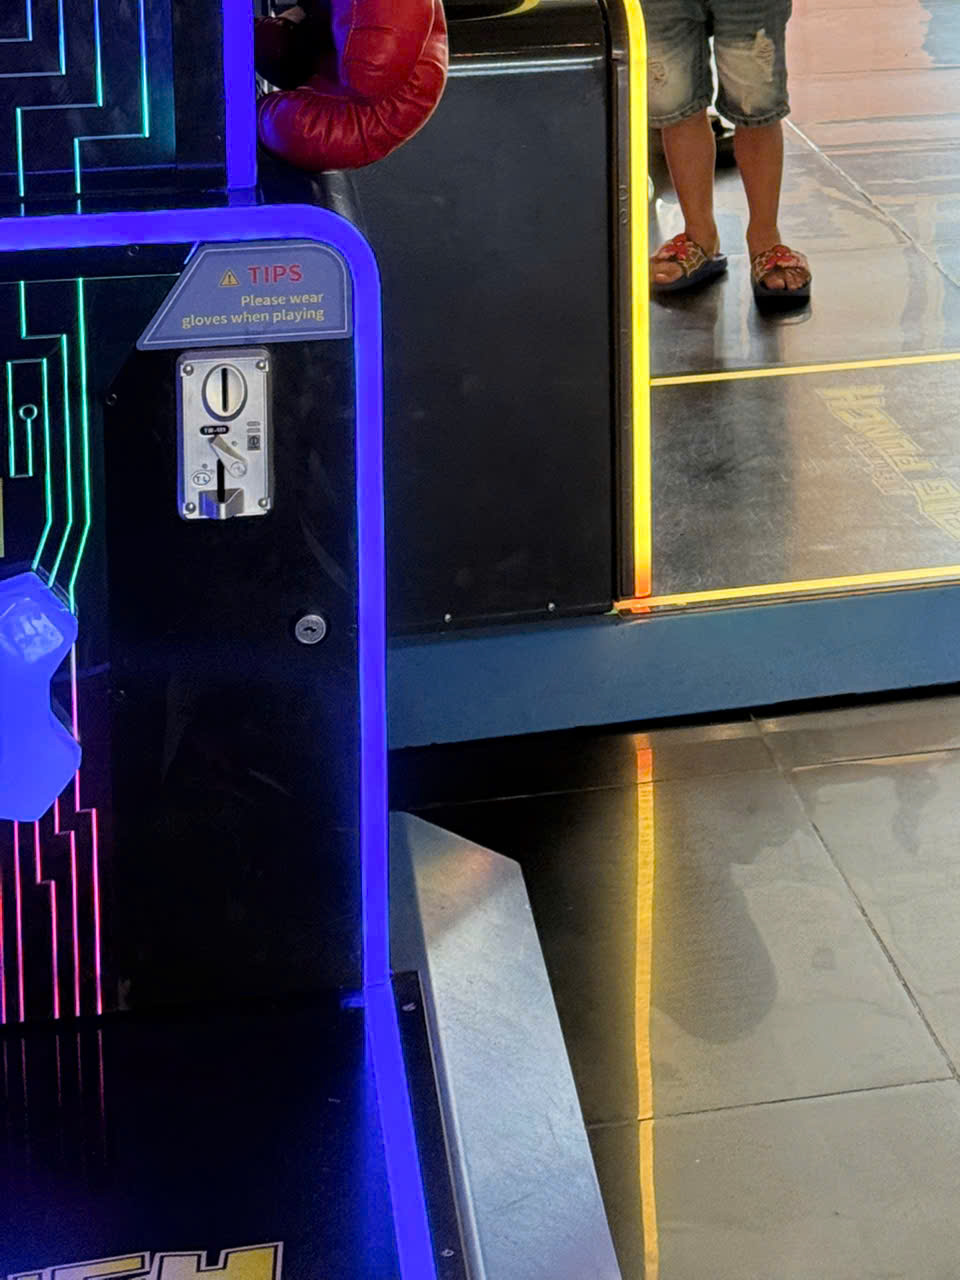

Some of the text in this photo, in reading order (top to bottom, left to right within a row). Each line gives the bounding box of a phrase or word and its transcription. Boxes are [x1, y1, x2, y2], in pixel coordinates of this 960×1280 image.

[247, 264, 303, 284] TIPS
[240, 292, 324, 307] Please wear
[181, 308, 325, 329] gloves when playing
